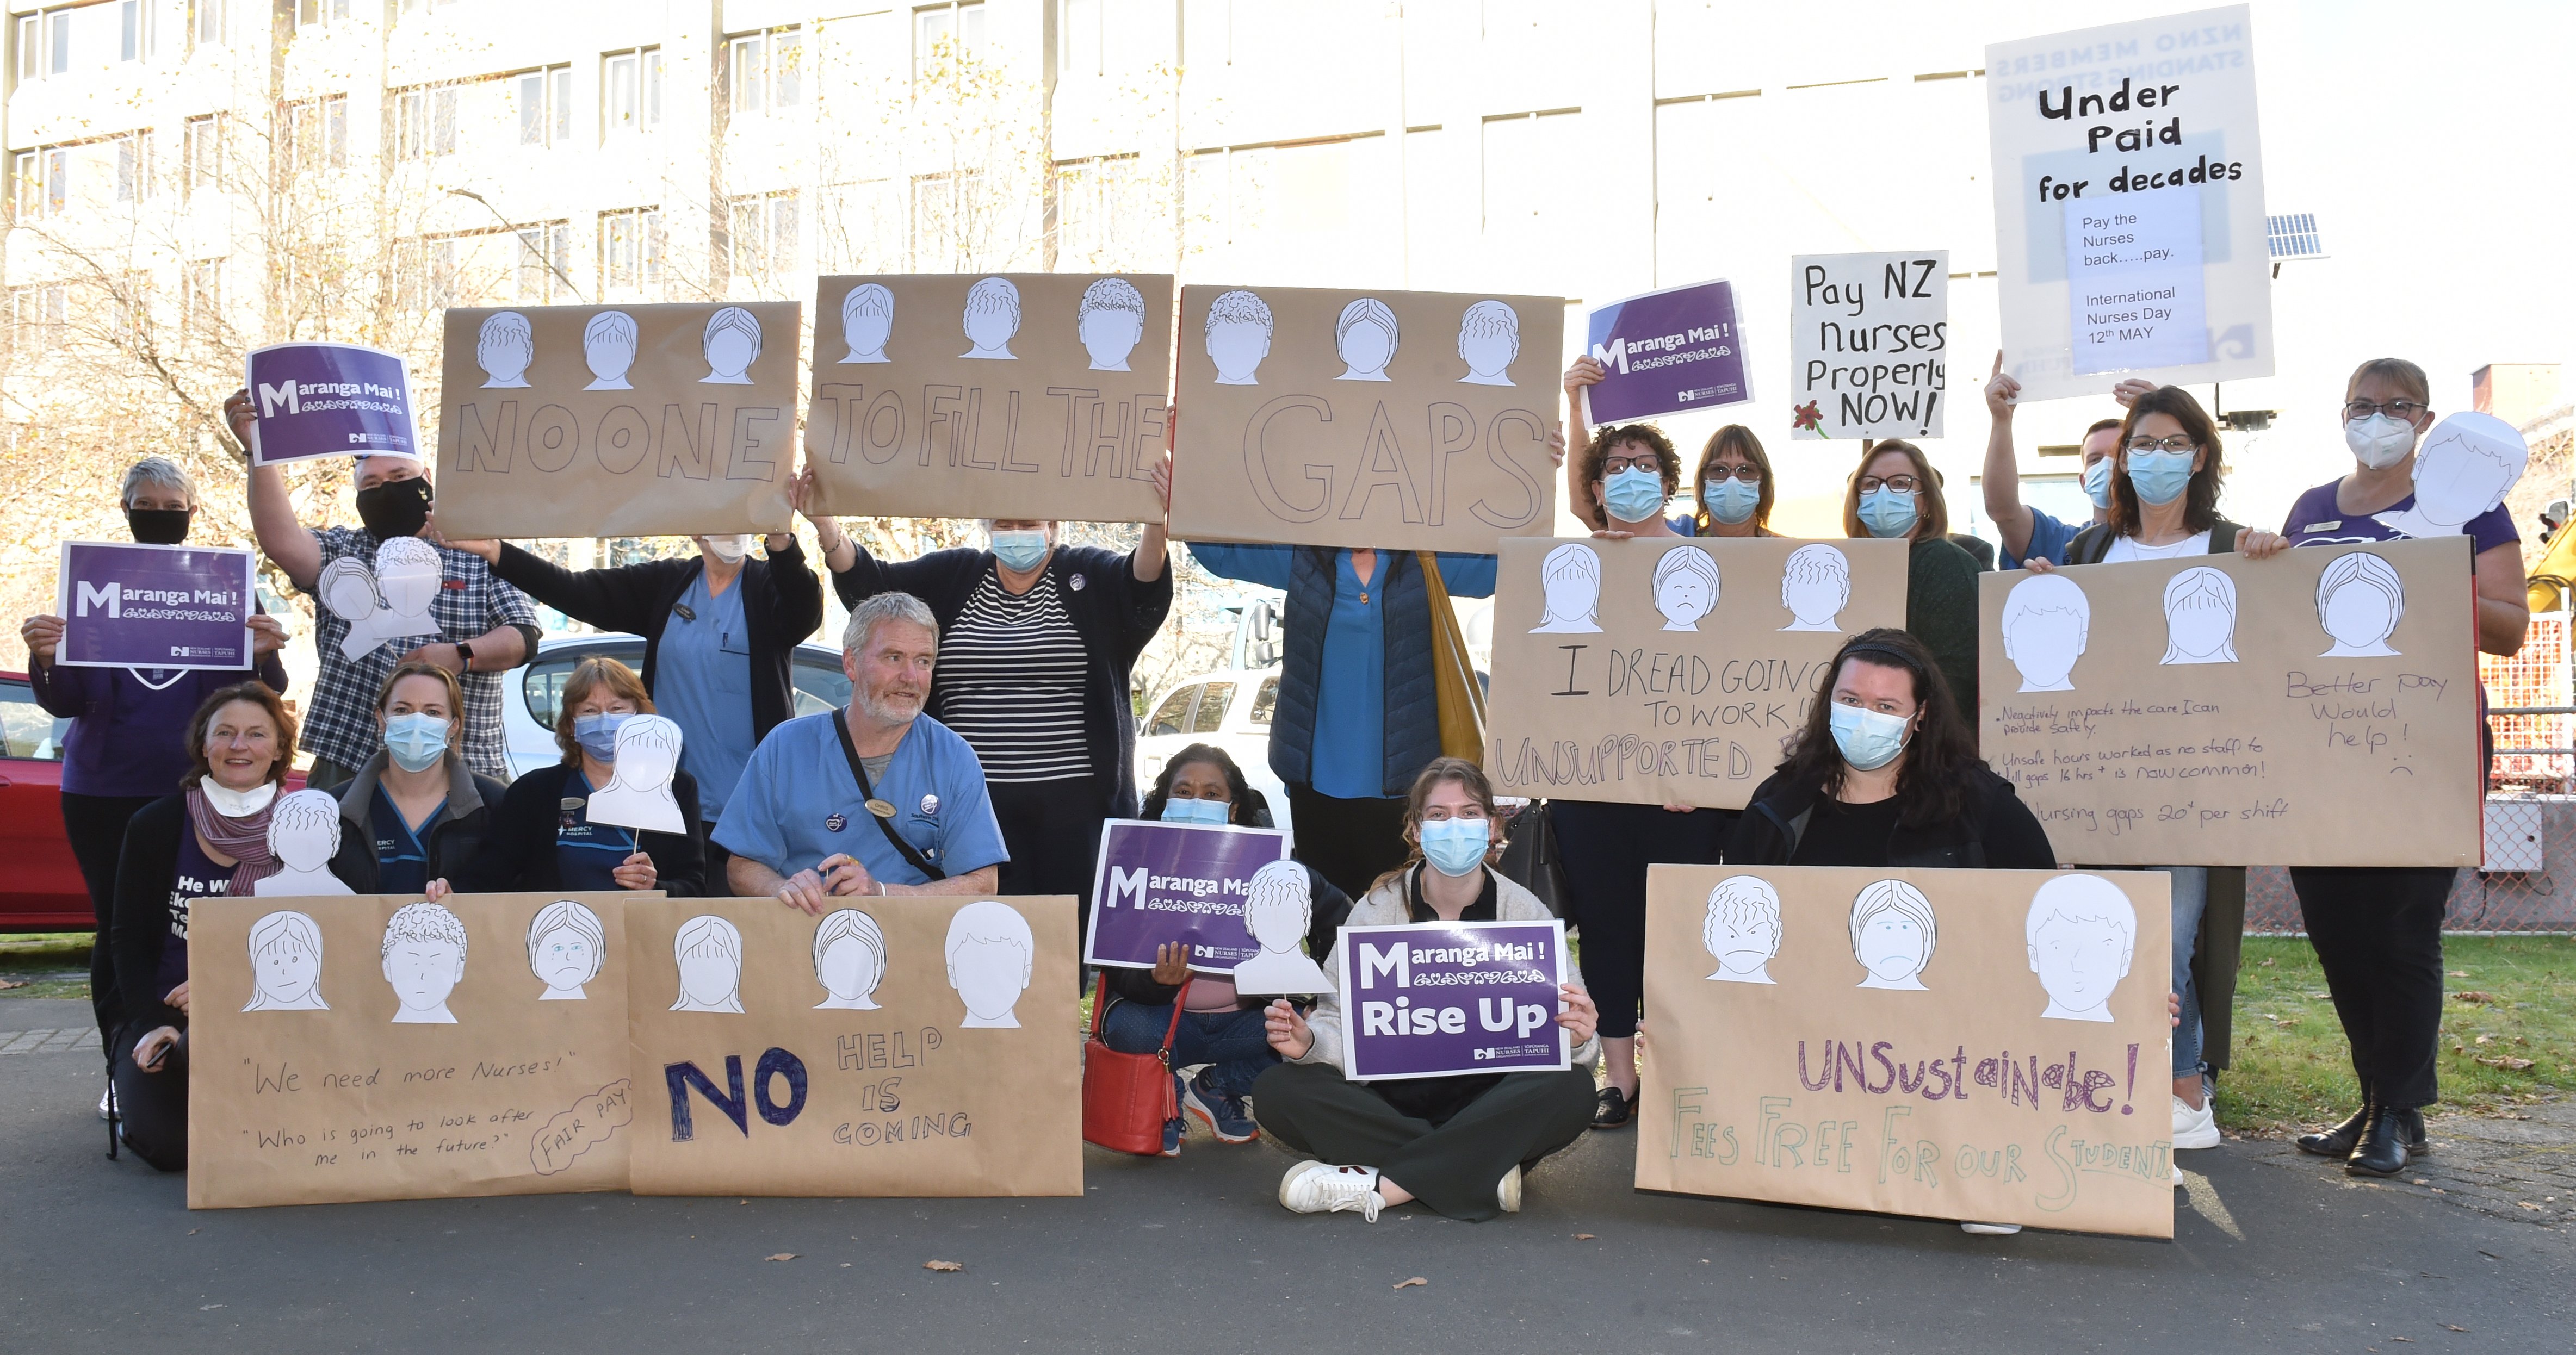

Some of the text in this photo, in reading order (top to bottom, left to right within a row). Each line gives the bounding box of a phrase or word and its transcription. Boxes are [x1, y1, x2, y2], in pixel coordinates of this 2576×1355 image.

[2039, 77, 2180, 121] Under
[2088, 117, 2182, 154] Paid
[2039, 154, 2243, 202] for decades
[2083, 214, 2137, 230] Pay the
[2084, 233, 2134, 247] Nurses
[1805, 260, 1937, 316] Pay NZ
[2086, 286, 2175, 307] International
[2088, 308, 2171, 325] Nurses Day
[2119, 326, 2153, 341] MAY
[1592, 328, 1686, 375] Maranga
[1688, 325, 1719, 344] Mai
[1807, 358, 1945, 394] Properly
[258, 380, 361, 418] Maranga
[364, 382, 392, 399] Mai
[1842, 391, 1937, 436] NOW!
[820, 383, 902, 465] TO
[918, 384, 1039, 473] FILL
[1243, 394, 1545, 528] GAPS
[76, 581, 190, 619] Maranga
[194, 590, 227, 605] Mai
[1550, 644, 1589, 697] I
[1608, 648, 1711, 697] DREAD
[2286, 672, 2381, 698] Better
[1644, 700, 1680, 728] TO
[2121, 699, 2142, 715] the
[2147, 705, 2177, 714] care
[1495, 734, 1751, 788] UNSUPPORTED
[2001, 737, 2263, 767] Unsafe hours worked as no staff to
[2025, 773, 2049, 789] gaps
[2060, 769, 2070, 782] 16
[2115, 767, 2126, 778] is
[2137, 767, 2175, 779] now
[2106, 809, 2144, 836] gaps
[2200, 810, 2231, 828] per
[2240, 798, 2289, 819] shift
[177, 875, 203, 893] He
[1106, 866, 1218, 910] Maranga
[1359, 942, 1489, 989] Maranga
[1494, 942, 1533, 961] Mai
[1361, 996, 1548, 1039] Rise Up
[837, 1026, 943, 1071] HELP
[323, 1068, 380, 1088] need
[404, 1069, 455, 1082] more
[664, 1046, 808, 1143] NO
[862, 1076, 903, 1113] IS
[323, 1129, 336, 1141] is
[350, 1124, 393, 1143] going
[408, 1119, 424, 1132] to
[440, 1115, 477, 1127] look
[490, 1109, 535, 1123] after
[541, 1088, 626, 1167] FAIR PAY
[833, 1112, 971, 1146] COMING
[315, 1153, 338, 1166] me
[361, 1149, 376, 1160] in
[396, 1144, 418, 1156] the
